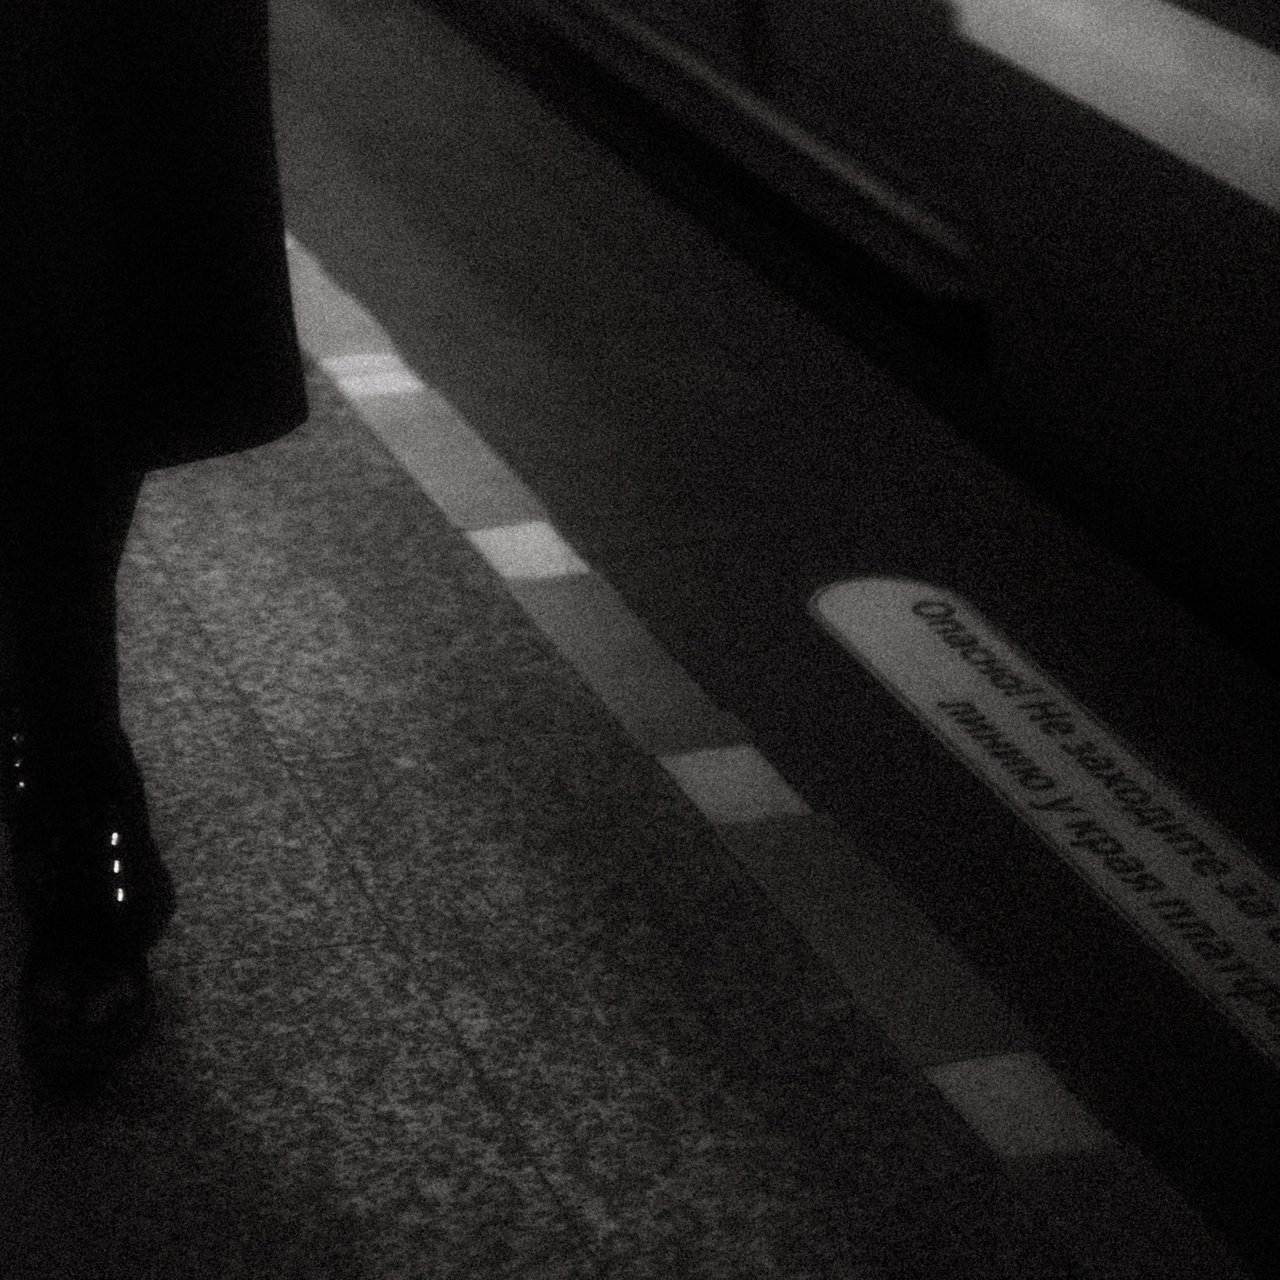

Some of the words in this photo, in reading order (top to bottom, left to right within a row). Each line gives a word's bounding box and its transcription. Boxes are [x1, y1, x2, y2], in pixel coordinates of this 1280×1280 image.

[911, 600, 1045, 697] Опасно!
[1017, 700, 1076, 737] Не
[1060, 741, 1232, 878] заходите
[1218, 881, 1278, 920] за
[937, 701, 1056, 790] линию
[1028, 796, 1084, 814] у
[1066, 819, 1165, 892] края
